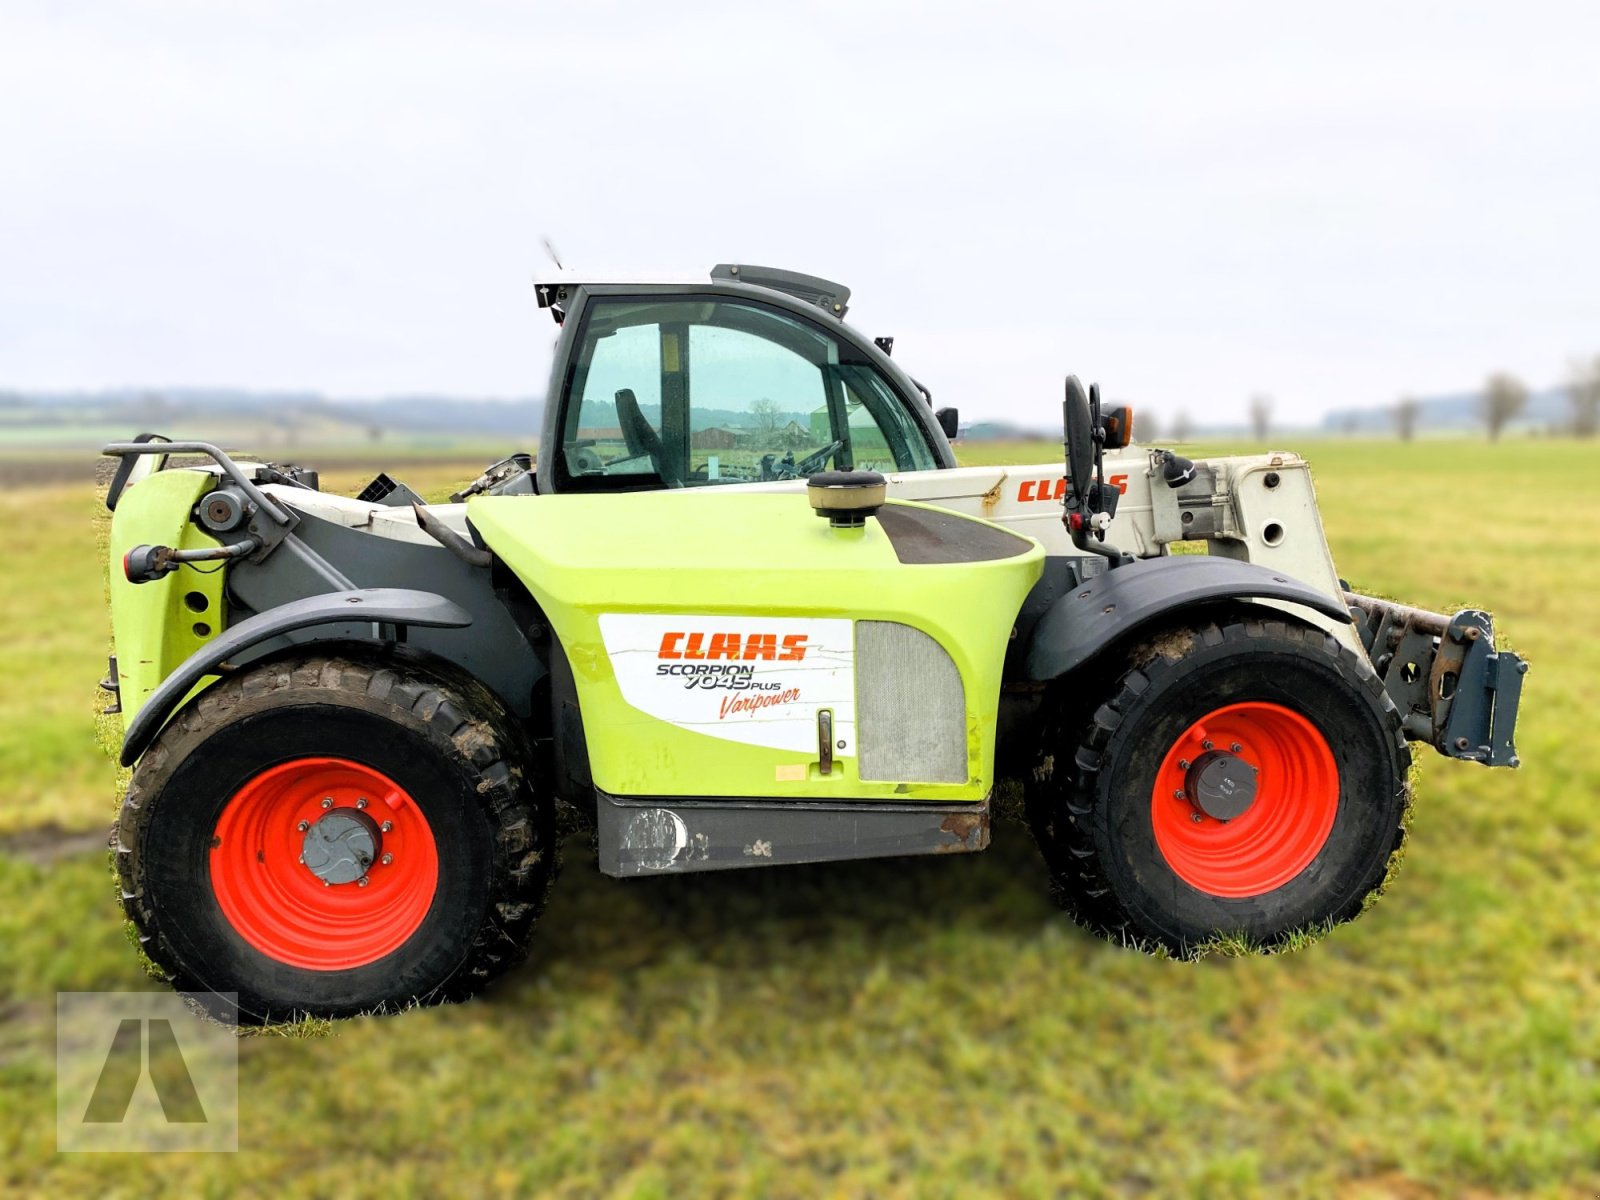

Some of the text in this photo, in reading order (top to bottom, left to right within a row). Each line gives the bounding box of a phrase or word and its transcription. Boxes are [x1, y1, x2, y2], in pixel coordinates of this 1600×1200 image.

[1018, 474, 1128, 502] CLS
[658, 632, 808, 661] CLAAS
[656, 664, 755, 678] SCORPION
[684, 674, 782, 690] 7045 PLUS
[719, 687, 801, 720] Varipower
